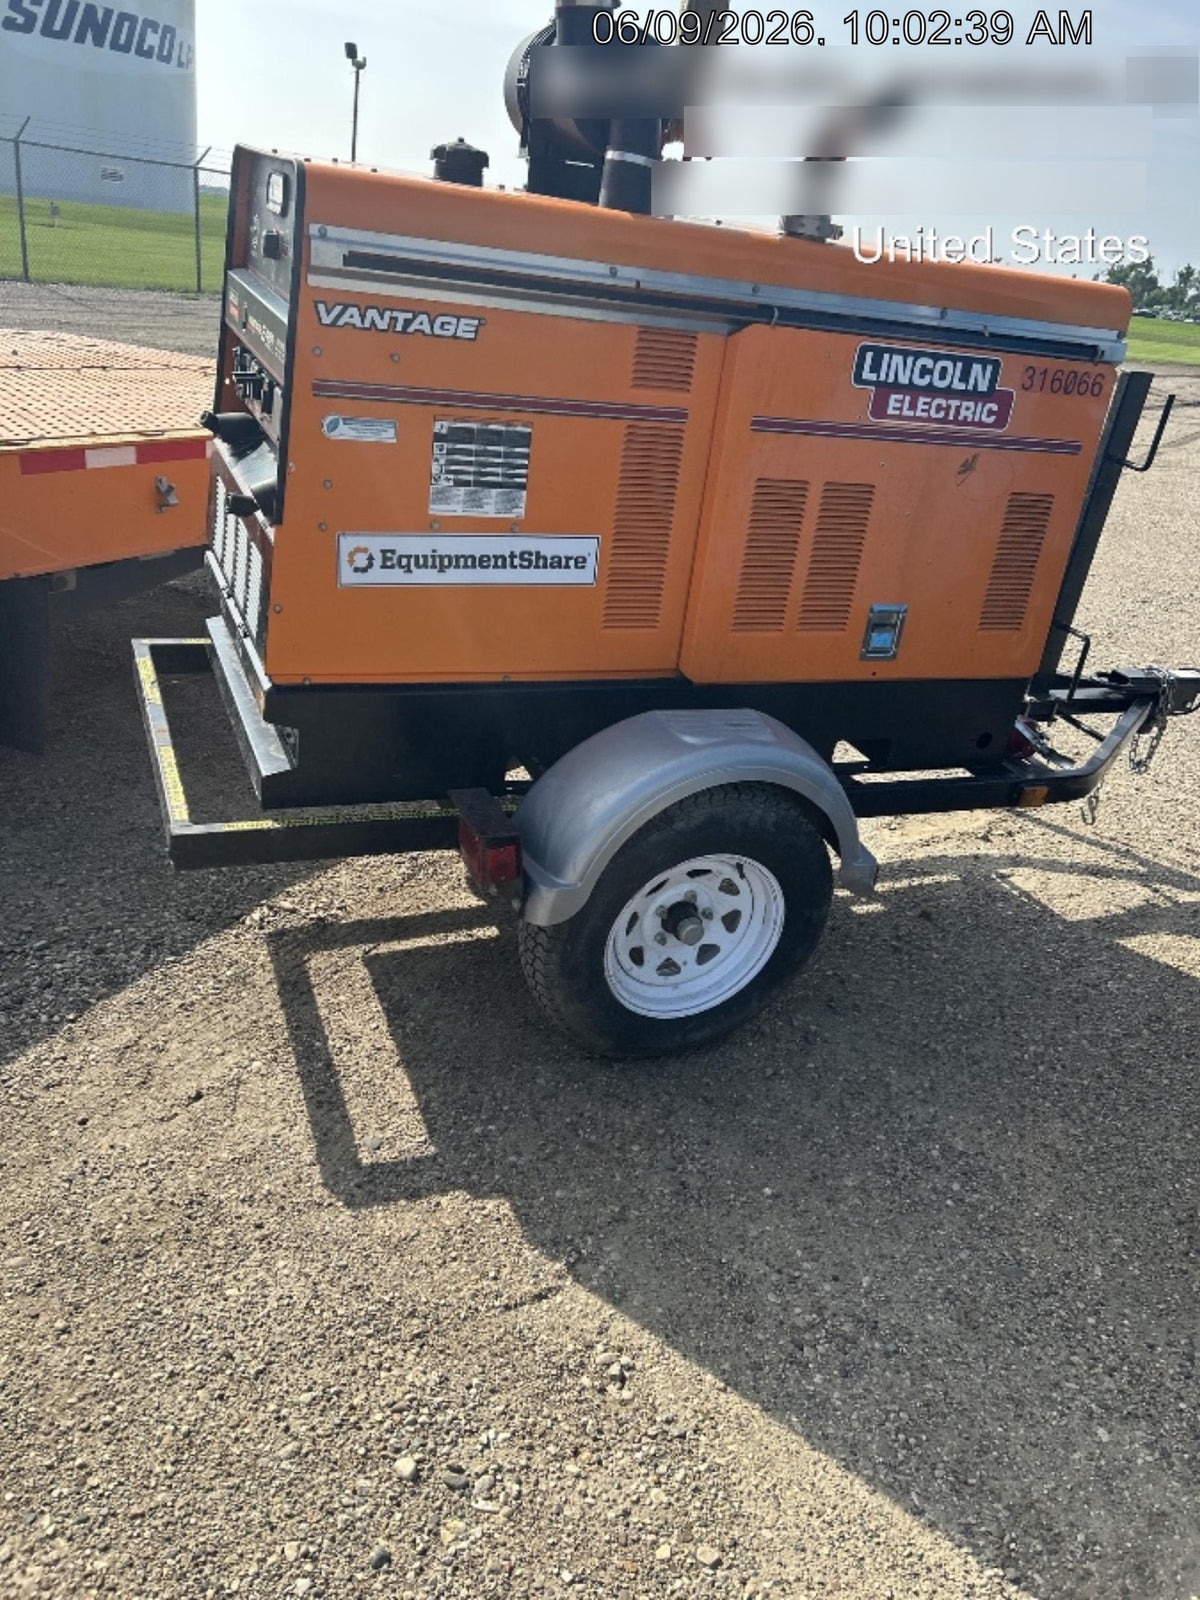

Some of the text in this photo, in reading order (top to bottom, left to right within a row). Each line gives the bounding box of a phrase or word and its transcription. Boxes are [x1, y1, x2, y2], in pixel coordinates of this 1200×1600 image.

[1, 0, 177, 65] SUNOCO
[314, 301, 480, 340] VANTAGE
[861, 351, 993, 393] LINCOLN
[1021, 365, 1106, 398] 316066
[886, 393, 999, 424] ELECTRIC
[379, 548, 588, 574] EquipmentShare
